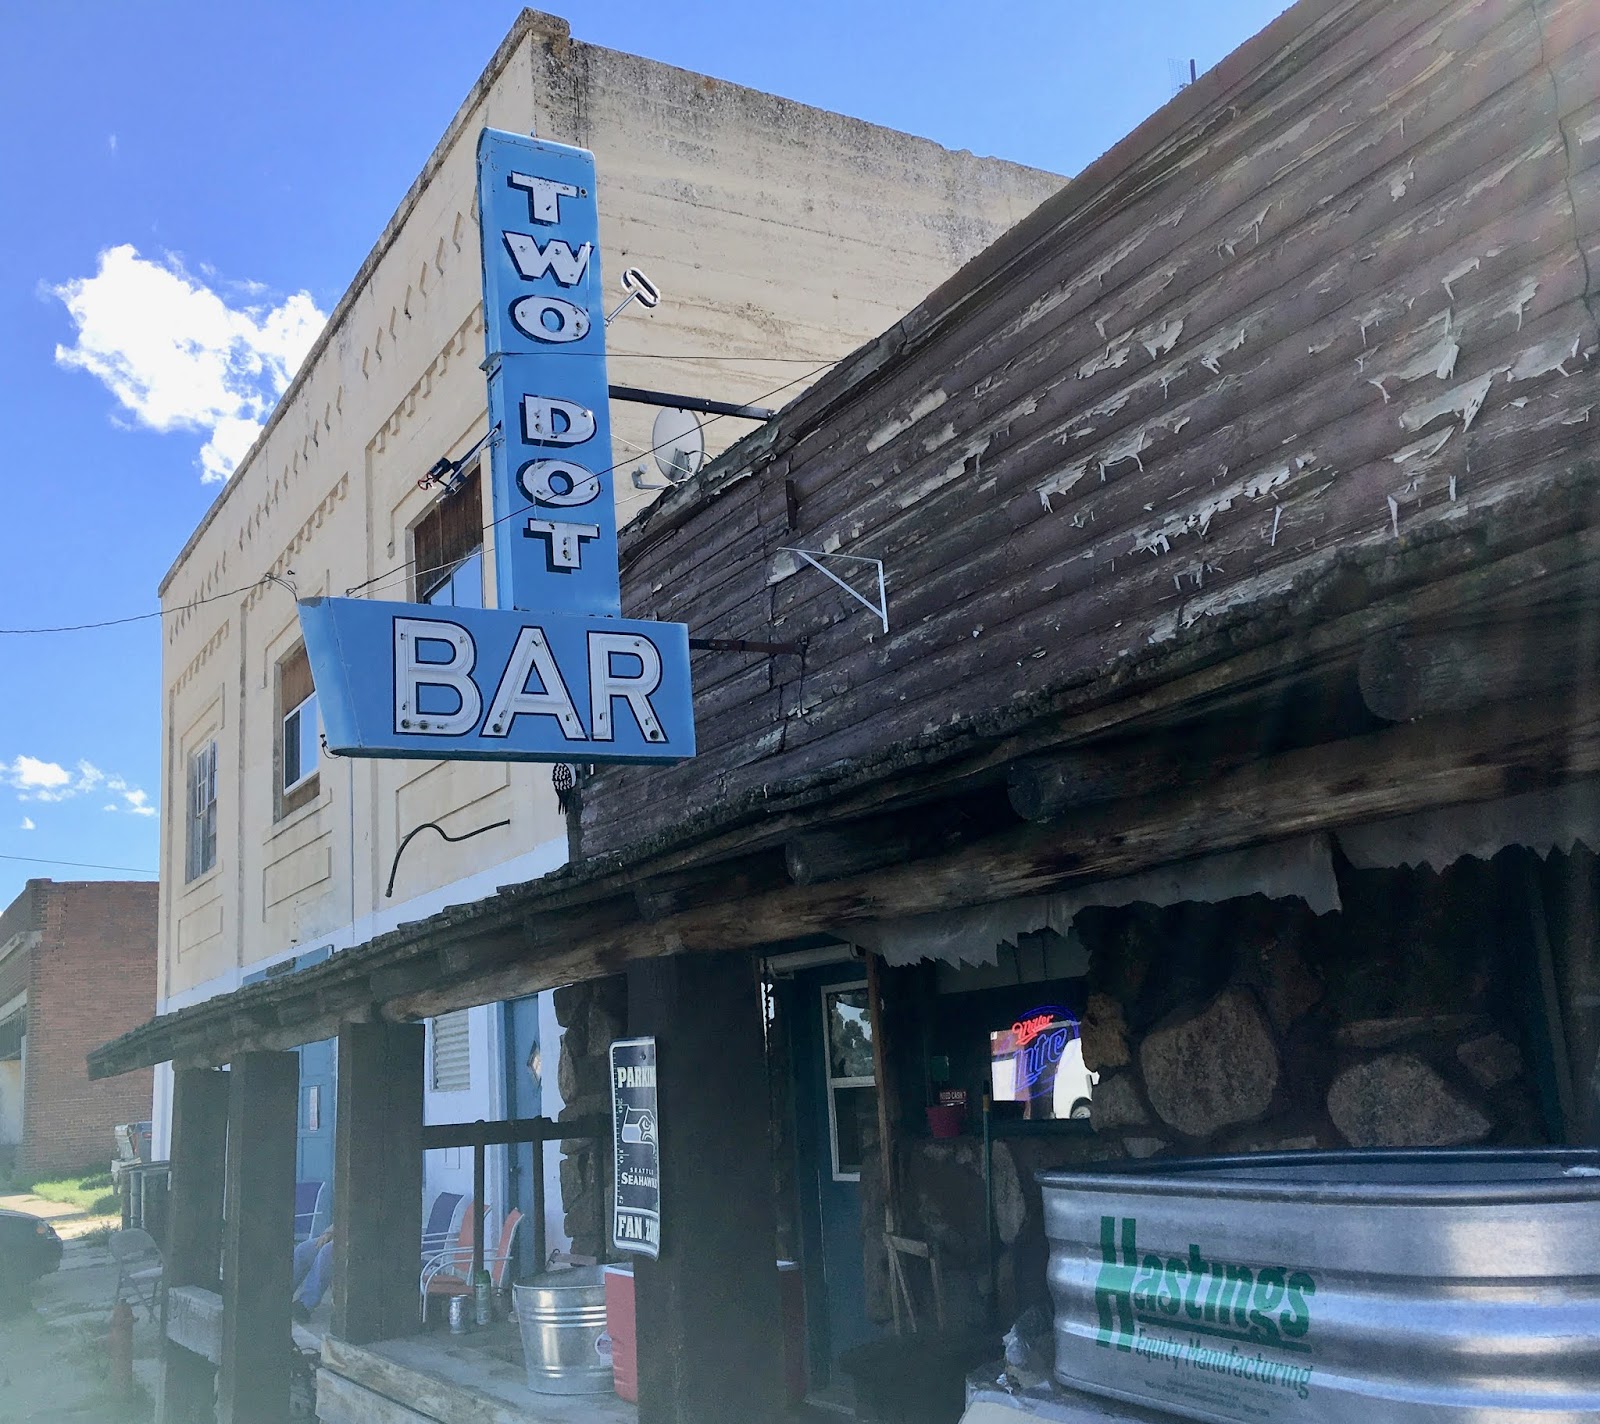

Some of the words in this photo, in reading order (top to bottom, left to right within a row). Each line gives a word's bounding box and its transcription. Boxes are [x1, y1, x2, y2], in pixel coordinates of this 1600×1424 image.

[501, 170, 593, 344] TWO
[517, 395, 601, 574] DOT
[392, 616, 670, 743] BAR
[1012, 1014, 1054, 1045] Miller
[617, 1214, 643, 1240] FAN
[1096, 1216, 1316, 1353] Hastings
[1136, 1327, 1185, 1369] Equity
[1186, 1338, 1314, 1399] Manufacturing
